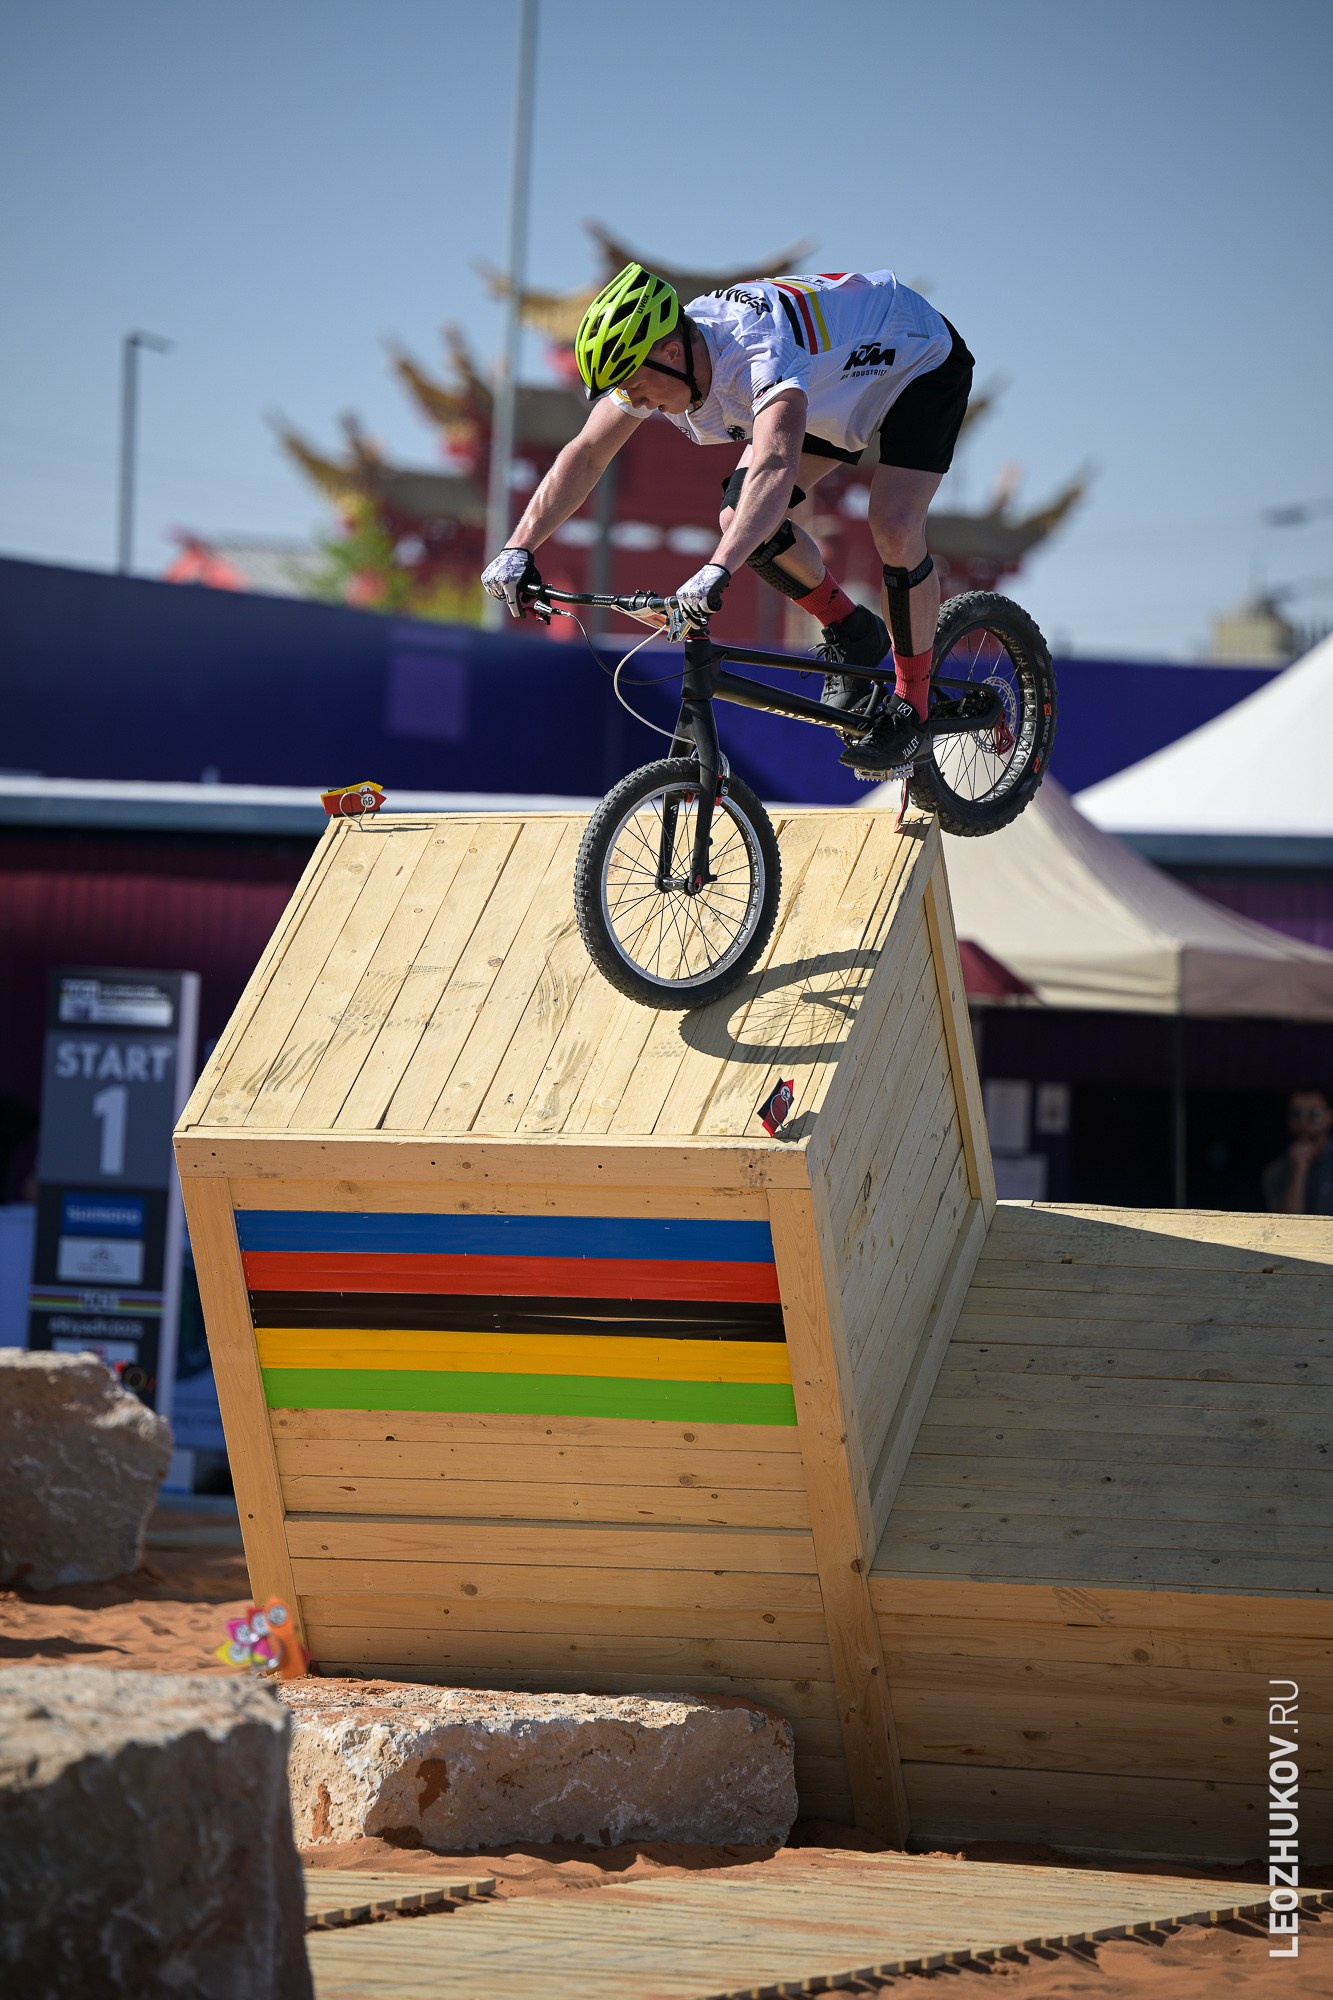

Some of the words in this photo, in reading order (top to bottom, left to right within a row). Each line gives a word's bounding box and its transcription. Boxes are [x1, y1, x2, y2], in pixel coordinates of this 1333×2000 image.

[843, 342, 896, 371] KTM
[56, 1040, 170, 1082] START
[92, 1084, 129, 1176] 1
